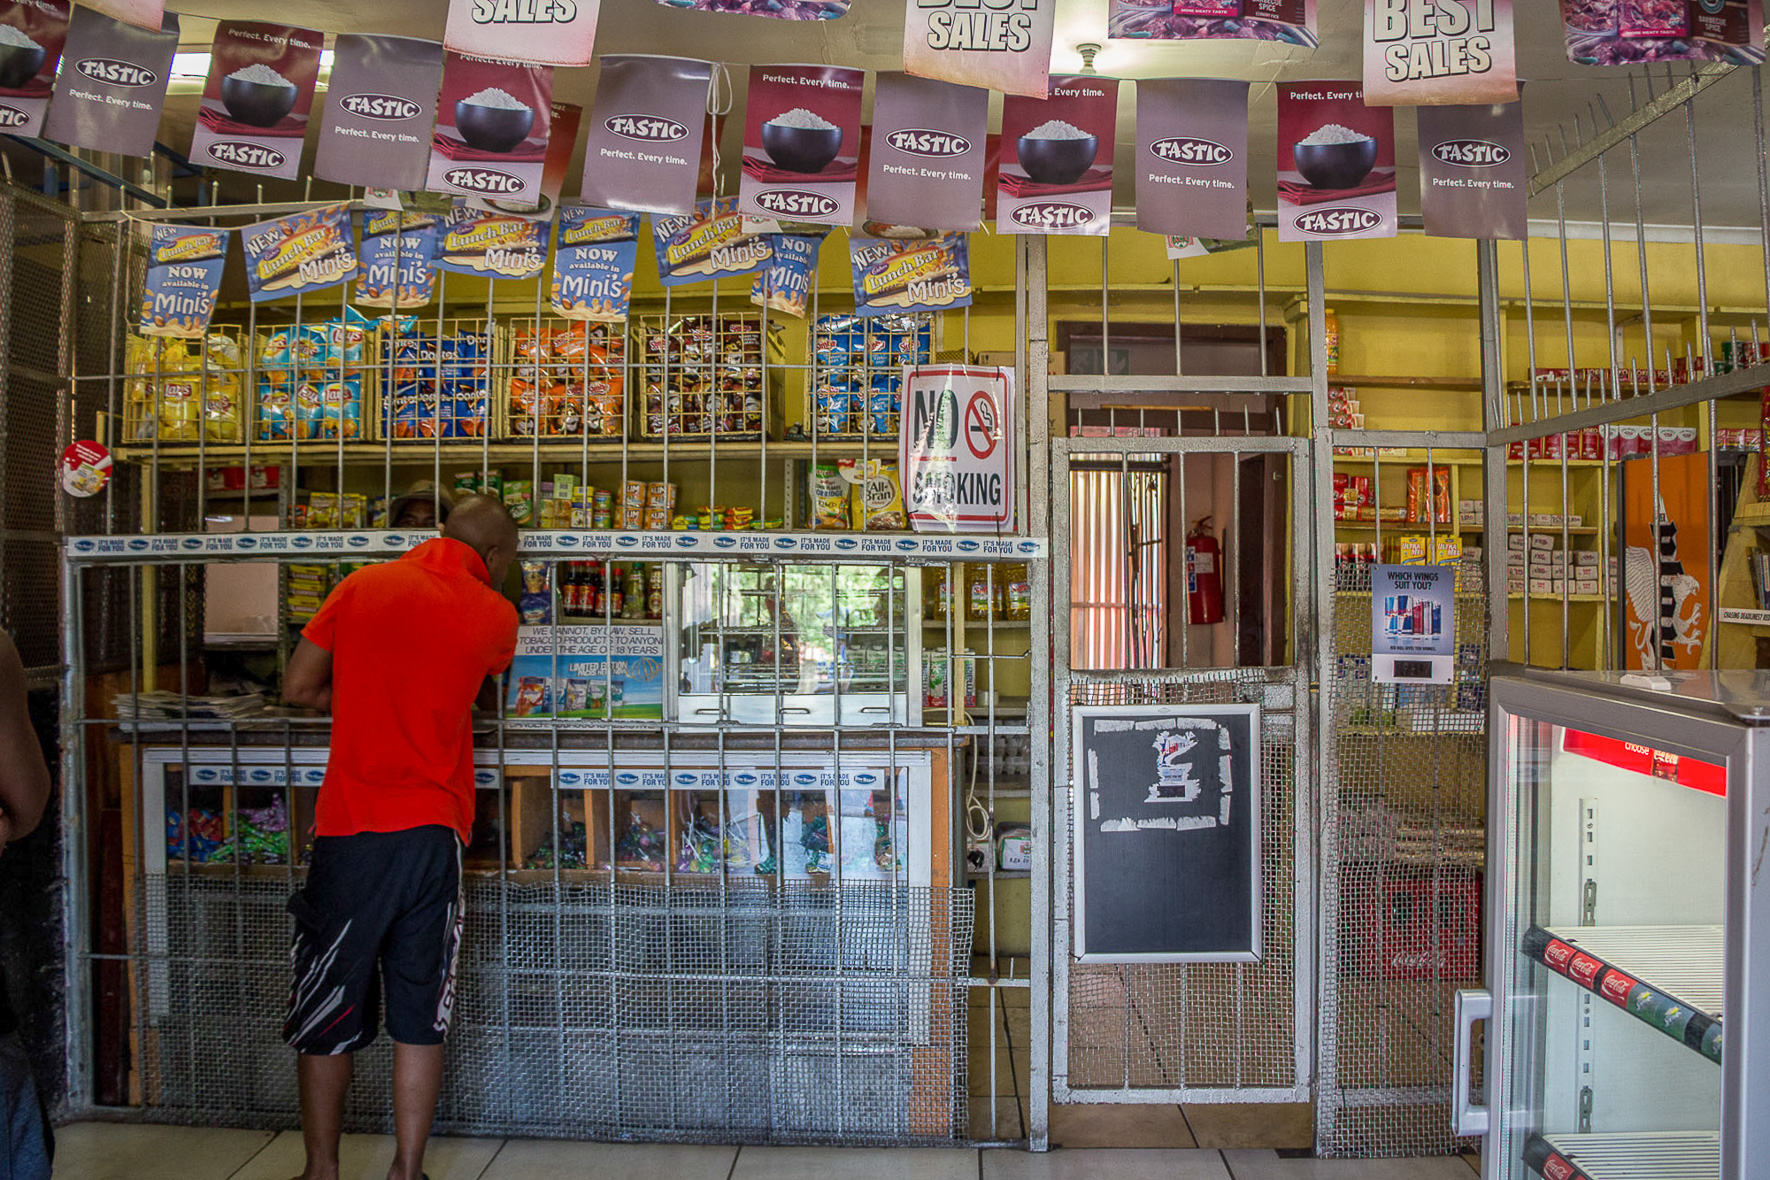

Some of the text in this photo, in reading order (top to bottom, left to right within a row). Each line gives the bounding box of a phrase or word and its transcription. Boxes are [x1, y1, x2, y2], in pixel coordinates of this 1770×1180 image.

[472, 0, 577, 24] SALES
[1258, 3, 1276, 12] SPICE
[927, 10, 1031, 52] SALES
[1373, 0, 1494, 42] BEST
[228, 28, 311, 49] Perfect. Every time.
[1385, 36, 1492, 82] SALES
[82, 61, 151, 85] TASTIC
[763, 74, 850, 89] Perfect. Every time.
[69, 89, 152, 110] Perfect. Every time.
[1054, 88, 1104, 97] Every time.
[1290, 91, 1353, 101] Perfect. Every
[0, 107, 27, 126] TIC
[347, 97, 416, 117] TASTIC
[335, 126, 419, 142] Perfect. Every time.
[612, 118, 683, 138] TASTIC
[893, 133, 965, 153] TASTIC
[1156, 141, 1227, 162] TASTIC
[213, 143, 280, 166] TASTIC
[600, 148, 688, 165] Perfect. Every time.
[1438, 144, 1505, 163] TASTIC
[450, 171, 520, 192] TASTIC
[883, 165, 971, 180] Perfect. Every time.
[1149, 174, 1235, 189] Perfect. Every time.
[1432, 178, 1514, 189] Perfect. Every time.
[761, 192, 833, 214] TASTIC
[445, 208, 478, 228] NEW
[563, 208, 585, 222] NEW
[1017, 205, 1089, 227] TASTIC
[1300, 211, 1375, 233] TASTIC
[156, 227, 177, 241] NEW
[452, 221, 525, 248] Lunch Bar
[568, 219, 621, 242] Lunch Bar
[655, 216, 691, 243] NEW
[672, 215, 741, 261] Lunch Bar
[161, 236, 212, 261] Lunch Bar
[246, 230, 281, 258] NEW
[265, 227, 329, 275] Lunch Bar
[380, 237, 421, 250] NOW
[710, 236, 767, 269] Mini's
[300, 247, 351, 282] Mini's
[374, 251, 413, 260] availble
[484, 246, 541, 270] Mini's
[575, 248, 618, 262] NOW
[853, 246, 888, 271] NEW
[168, 266, 208, 280] NOW
[569, 262, 609, 271] available
[869, 250, 938, 290] Lunch Bar
[162, 280, 199, 289] available
[562, 273, 622, 298] Mini's
[908, 273, 965, 302] Mini's
[155, 292, 210, 315] Mini's
[421, 350, 459, 360] Dotos
[913, 390, 959, 449] NO
[625, 484, 641, 495] LIM
[816, 489, 842, 497] ORRIDGE
[866, 490, 891, 501] Bran
[870, 482, 888, 492] All-
[625, 510, 641, 520] LIM
[642, 541, 671, 549] FOR YOU
[1387, 571, 1439, 582] WHICH WINGS
[1395, 582, 1432, 591] SUIT YOU?
[532, 627, 548, 635] WE
[590, 627, 604, 635] BY
[616, 637, 628, 645] TO
[628, 637, 663, 645] ANYON
[560, 646, 577, 654] THE
[578, 646, 597, 654] AGE
[616, 646, 625, 654] 18
[628, 646, 658, 655] YEARS
